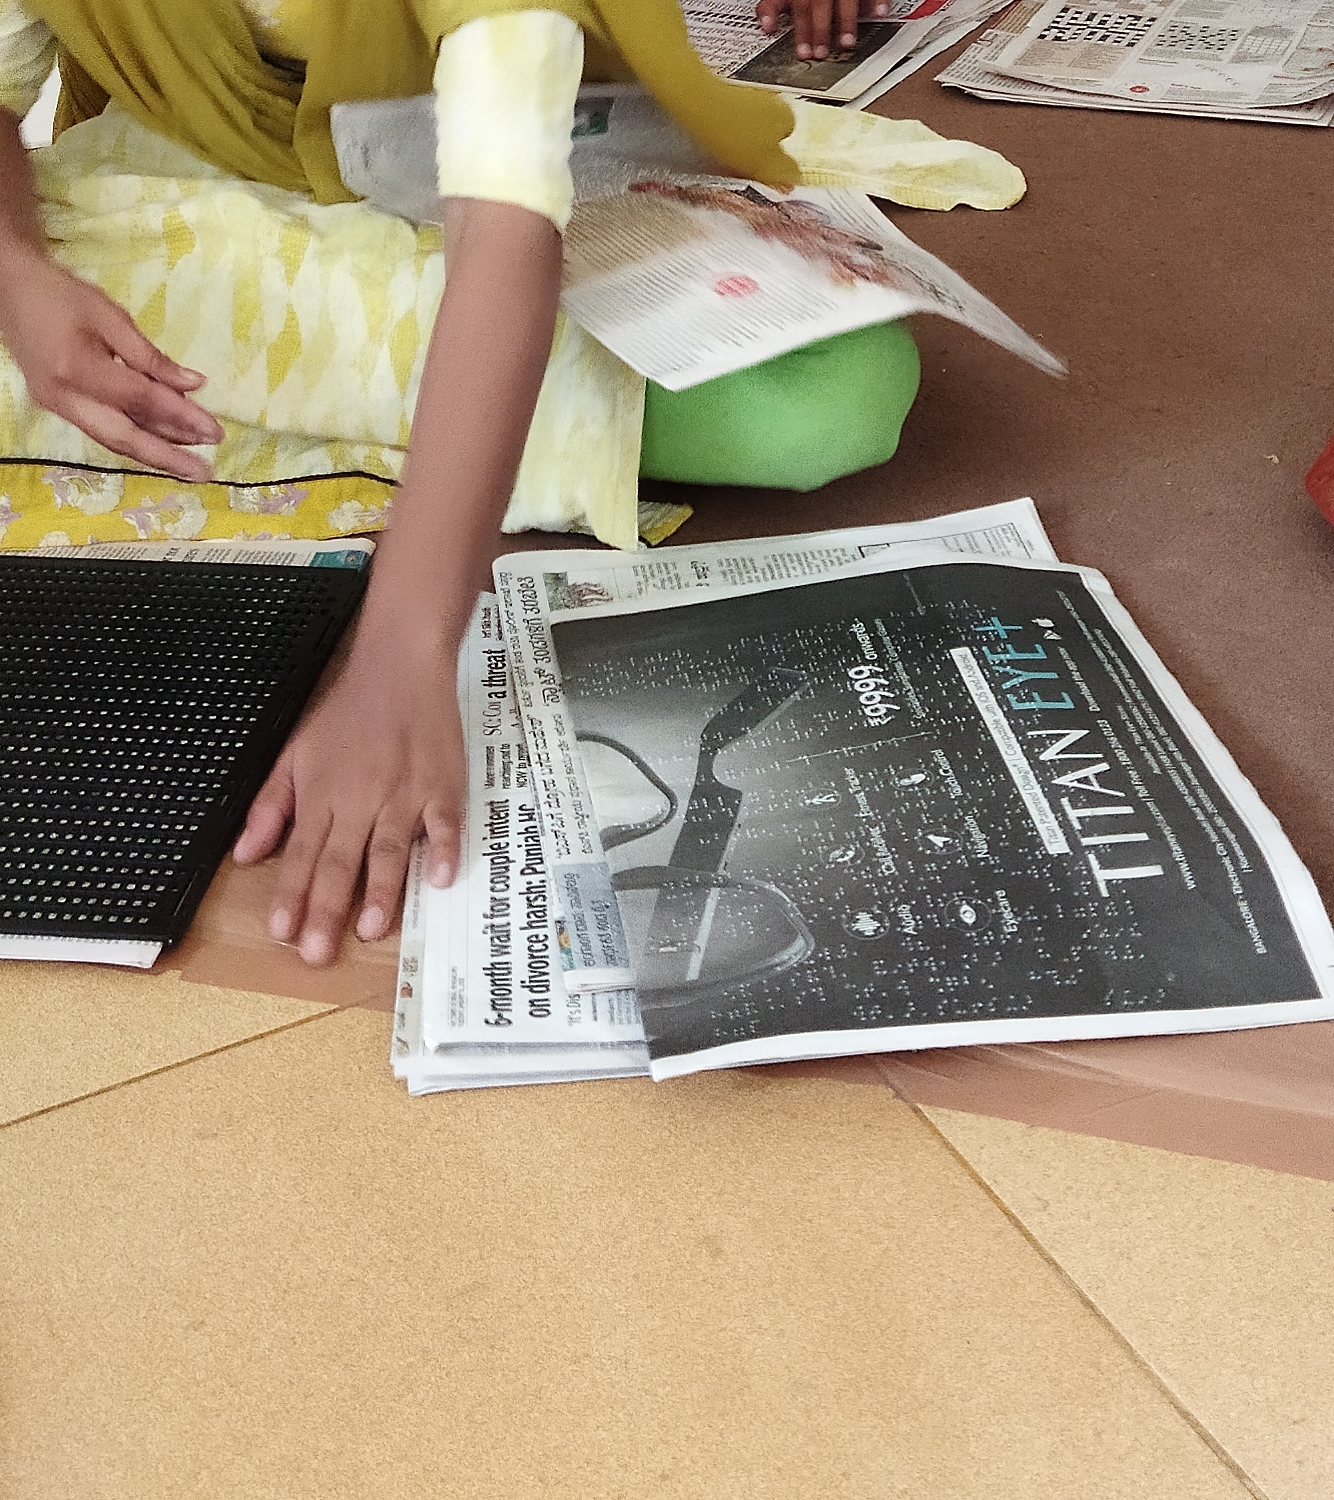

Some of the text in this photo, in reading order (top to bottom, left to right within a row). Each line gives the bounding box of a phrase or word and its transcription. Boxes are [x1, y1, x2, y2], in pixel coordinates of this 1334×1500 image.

[481, 648, 506, 698] a threat
[956, 650, 979, 682] Android
[848, 665, 900, 726] ₹9999
[982, 701, 998, 720] with
[483, 717, 501, 735] SC:
[990, 717, 1017, 757] Compatible
[931, 746, 963, 798] Touch Control
[1026, 789, 1052, 828] Patented
[1026, 728, 1164, 898] TITAN
[966, 815, 991, 858] Navigation
[1042, 824, 1061, 846] Titan
[483, 800, 513, 1029] 6-month wait for couple intent
[517, 870, 547, 927] harsh:
[898, 904, 918, 935] Audio
[995, 889, 1019, 933] Eyecare
[1237, 900, 1266, 954] BANGALORE
[518, 931, 547, 987] divorce
[526, 991, 547, 1018] on
